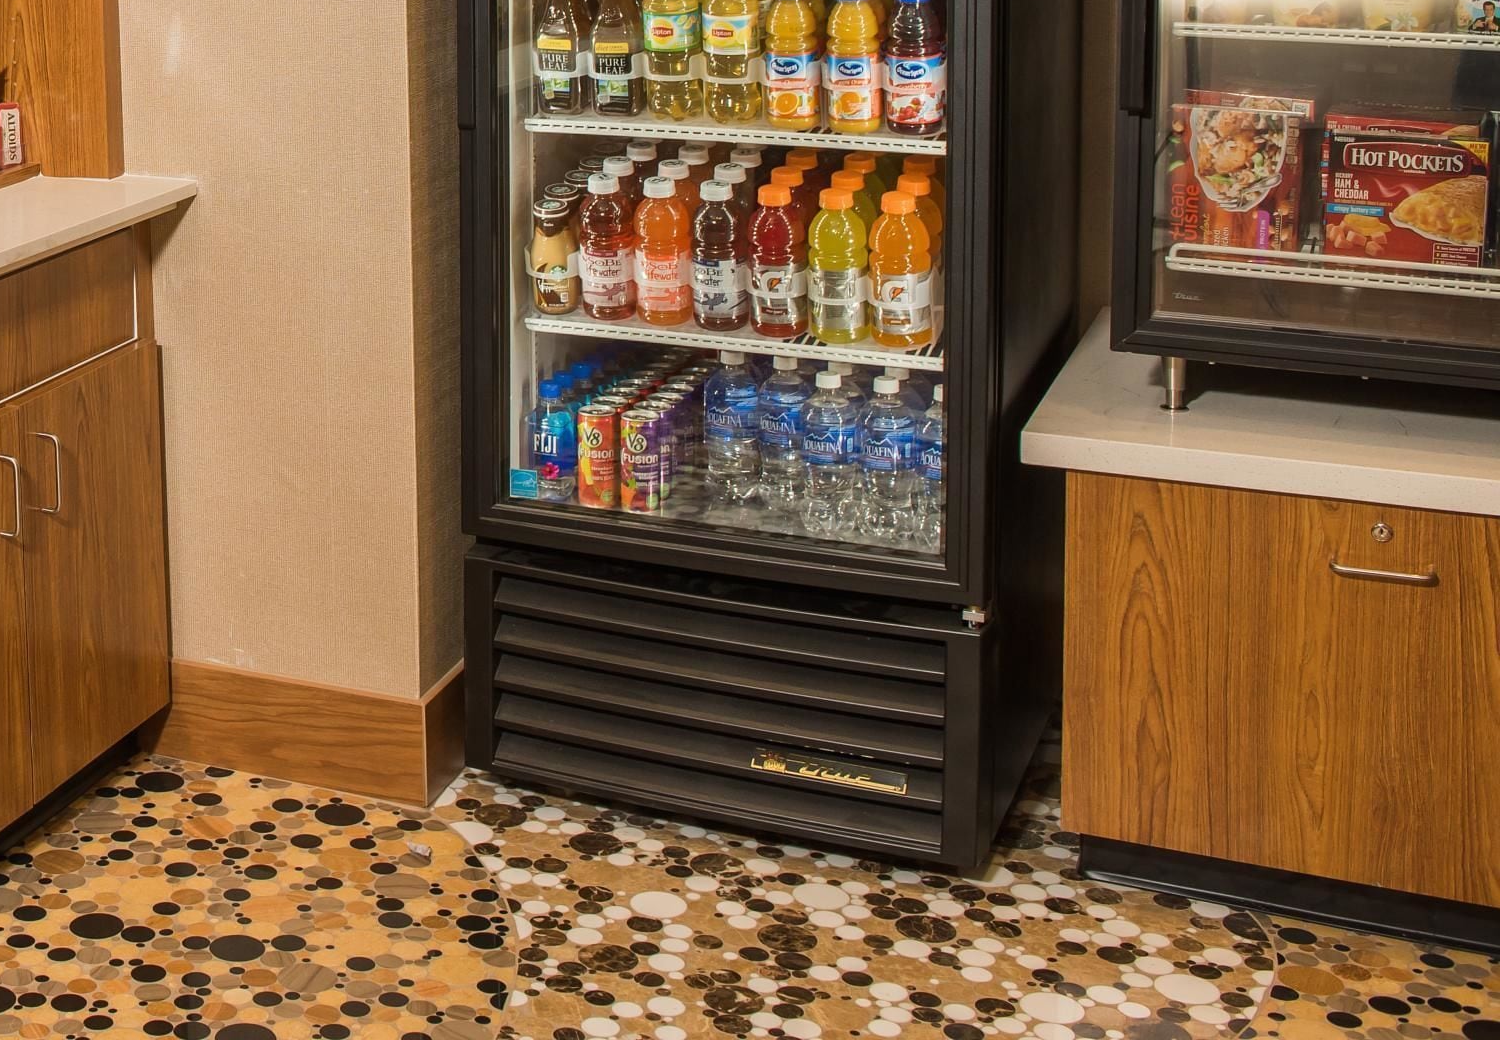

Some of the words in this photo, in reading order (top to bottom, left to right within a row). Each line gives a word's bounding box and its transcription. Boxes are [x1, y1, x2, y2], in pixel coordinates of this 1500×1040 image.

[652, 28, 672, 37] Lipton
[542, 54, 568, 64] PURE
[599, 57, 625, 67] PURE
[543, 62, 567, 71] LEAF
[599, 66, 625, 75] LEAF
[7, 112, 18, 161] ALTOIDS
[1351, 147, 1386, 167] HOT
[1388, 149, 1465, 173] POCKETS
[1334, 178, 1351, 188] HAM
[1353, 179, 1360, 189] &
[1334, 188, 1369, 200] CHEDDAR
[760, 417, 796, 435] AQUAFINA
[585, 427, 601, 447] V8
[628, 433, 645, 452] V8
[534, 434, 557, 454] FIJI
[803, 438, 842, 454] AQUAFINA
[623, 453, 659, 464] FUSION
